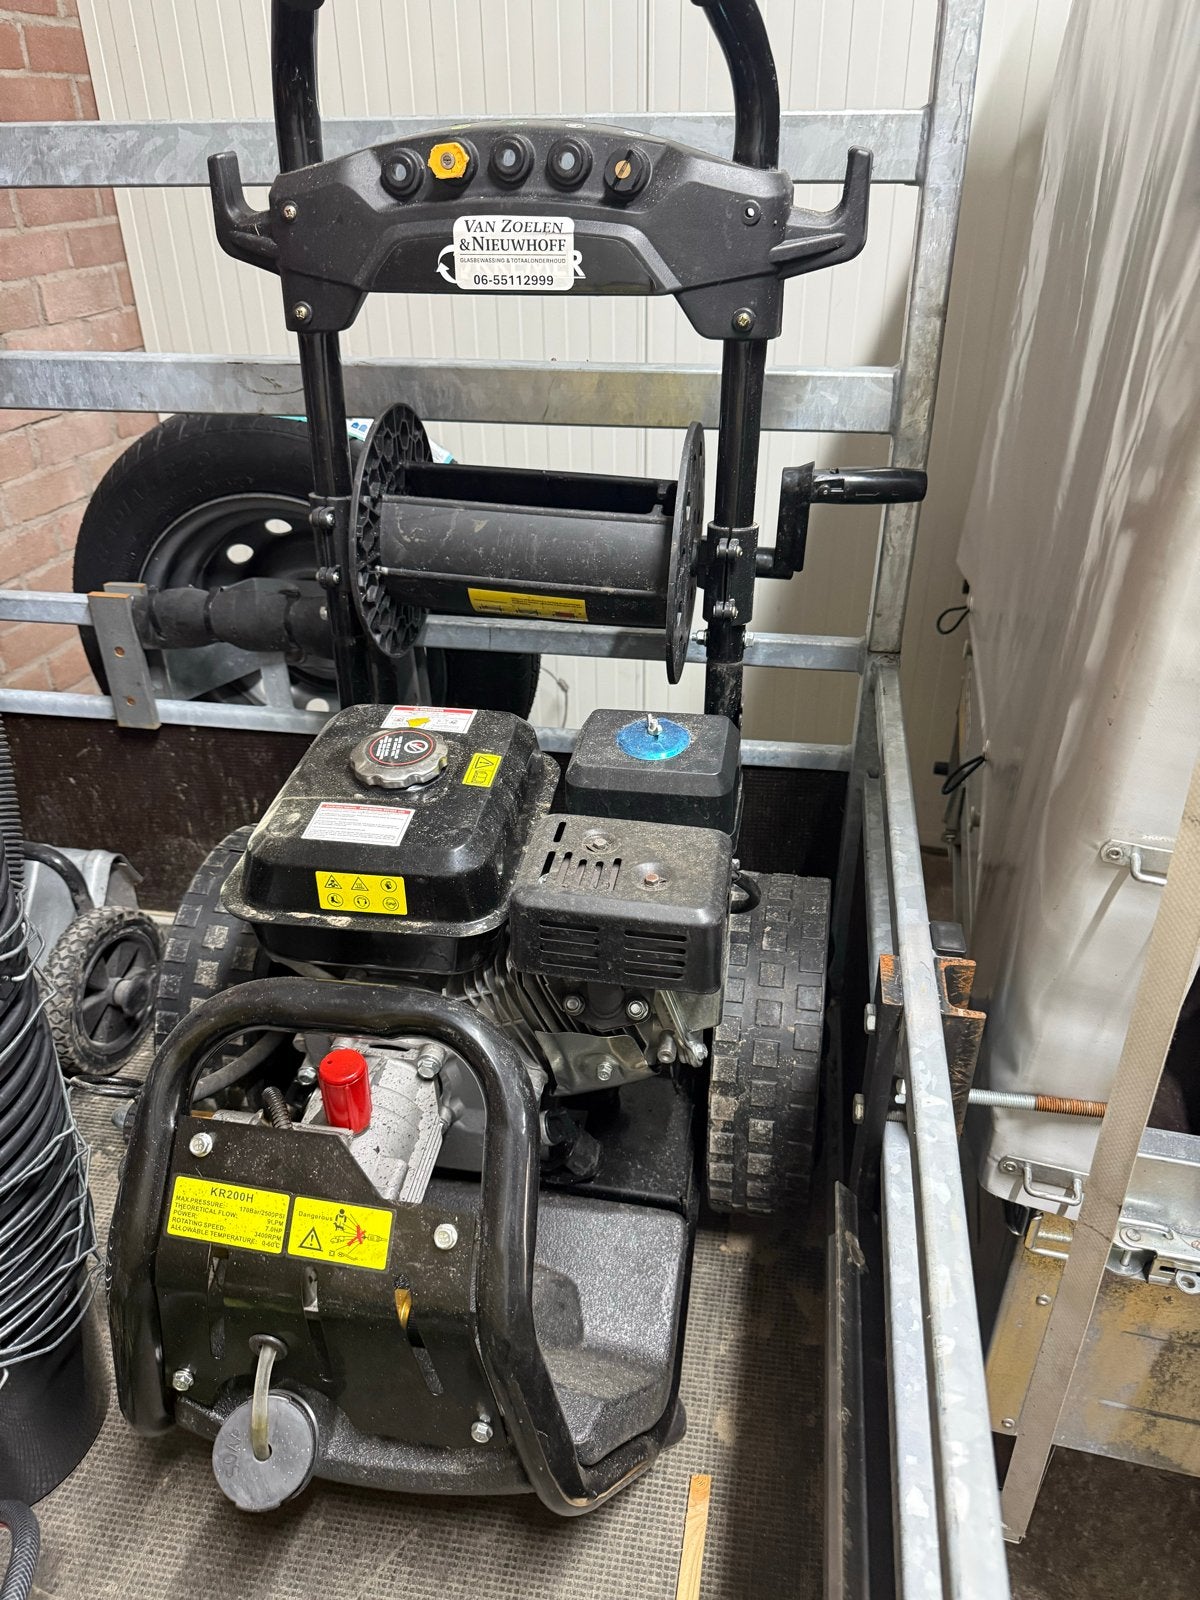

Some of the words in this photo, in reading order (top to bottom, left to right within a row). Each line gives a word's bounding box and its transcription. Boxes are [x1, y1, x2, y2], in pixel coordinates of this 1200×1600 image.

[464, 219, 496, 233] VAN
[501, 219, 564, 234] ZOELEN
[473, 274, 555, 286] 06-55112999
[210, 1187, 254, 1203] KR200H
[172, 1209, 198, 1219] POWER:
[174, 1202, 217, 1215] THEORETICAL
[298, 1210, 334, 1222] Dangerous
[171, 1216, 203, 1227] ROTATING
[203, 1222, 227, 1232] SPEED:
[170, 1223, 209, 1235] ALLOWABLE
[210, 1230, 258, 1245] TEMPERATURE:
